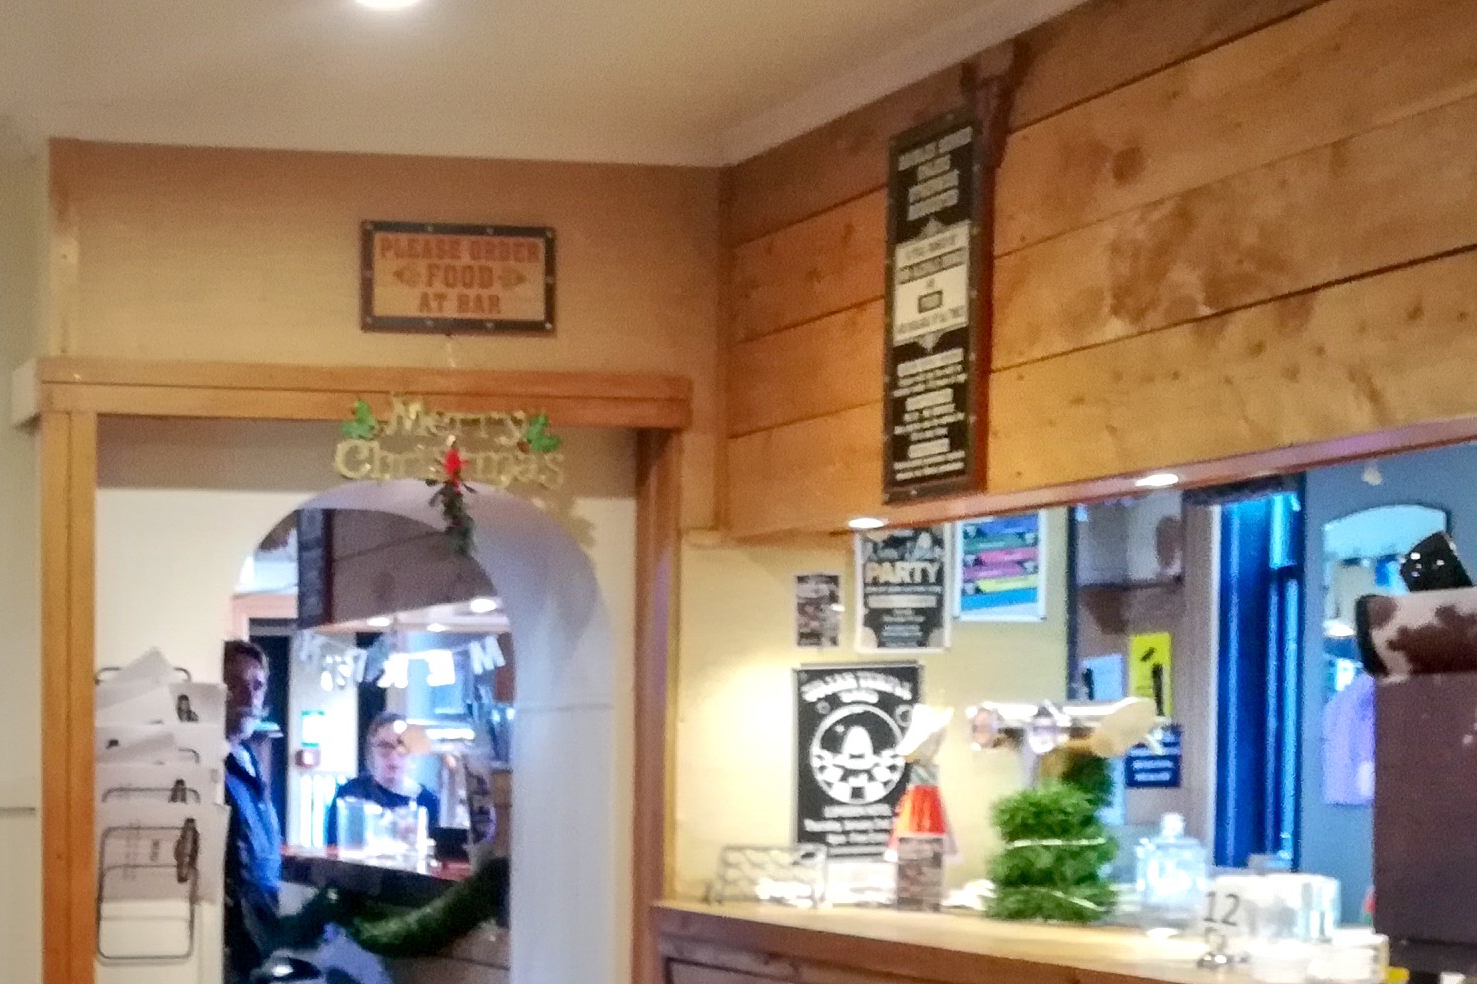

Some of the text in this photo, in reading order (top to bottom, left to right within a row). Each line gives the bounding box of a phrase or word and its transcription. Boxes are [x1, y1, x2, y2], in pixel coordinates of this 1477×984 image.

[380, 237, 540, 263] PLEASE ORDER
[426, 263, 493, 289] FOOD
[419, 291, 501, 314] AT BAR
[865, 561, 941, 584] PARTY
[1203, 890, 1241, 927] 12
